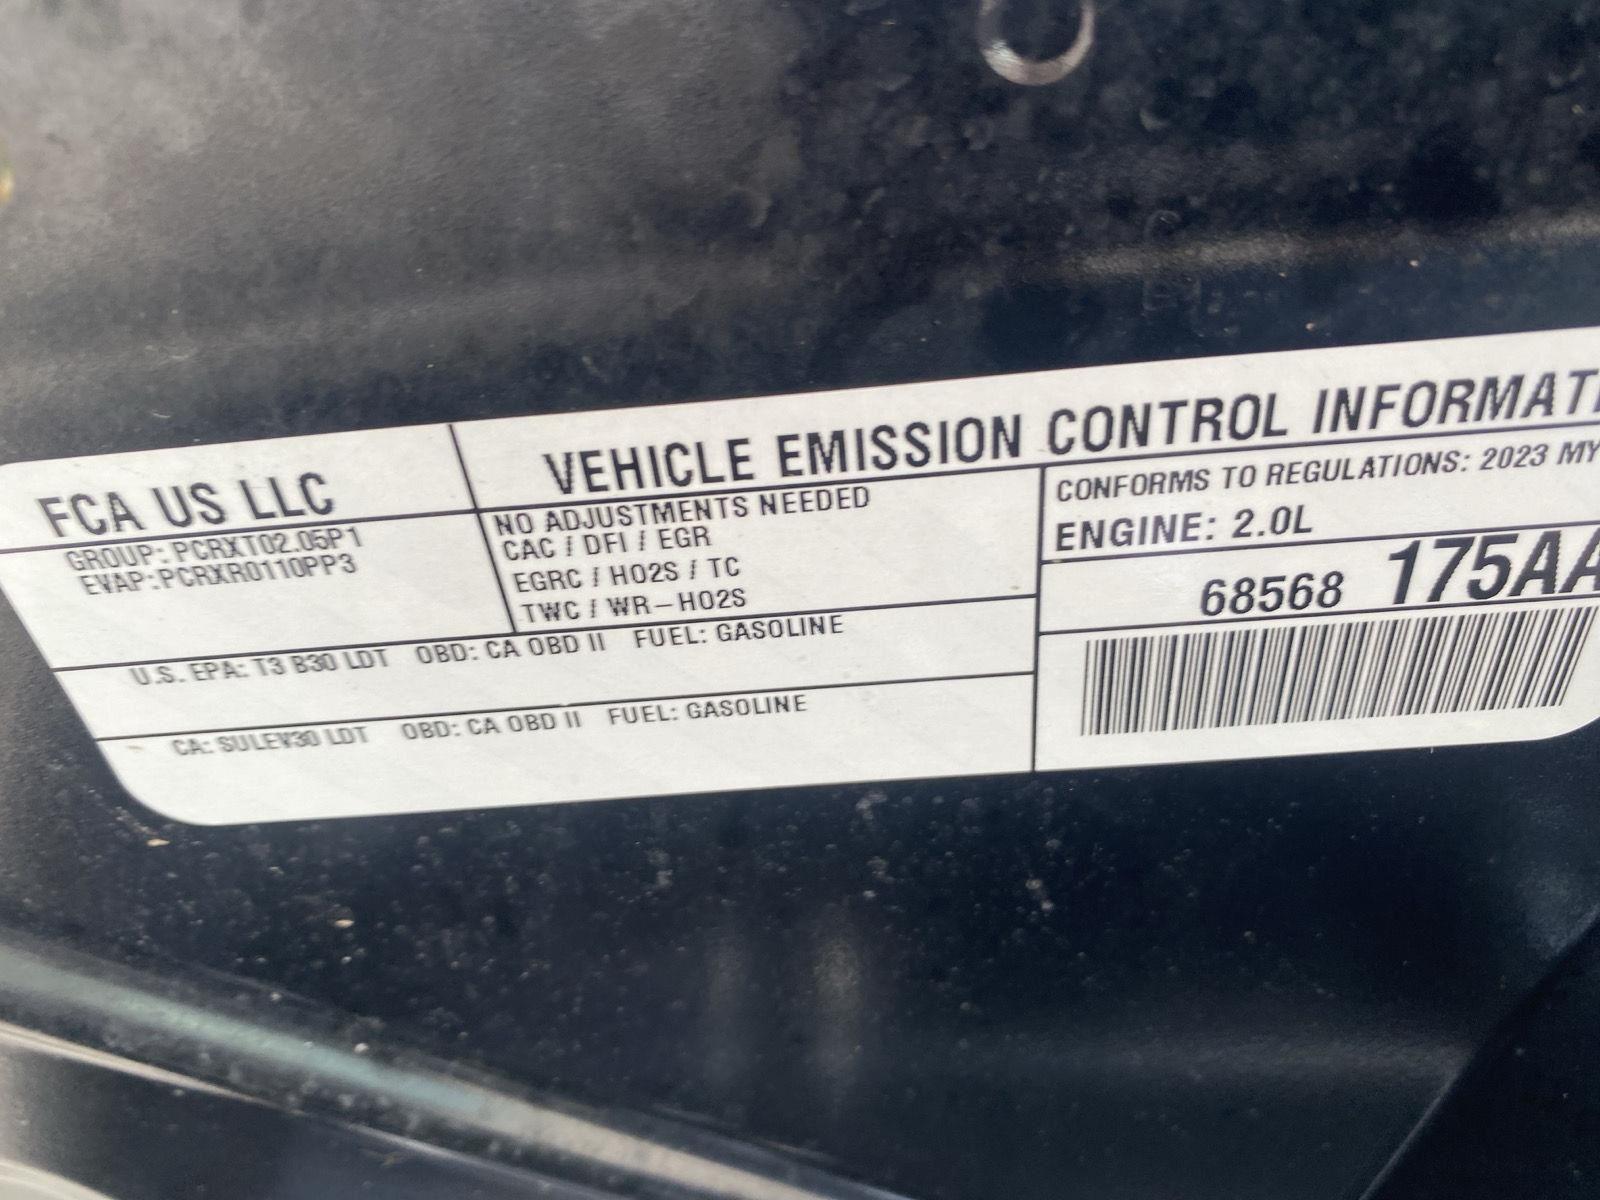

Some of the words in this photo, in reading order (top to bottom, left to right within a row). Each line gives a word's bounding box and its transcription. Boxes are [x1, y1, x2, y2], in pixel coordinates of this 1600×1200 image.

[544, 437, 754, 496] VEHICLE
[777, 414, 1022, 477] EMISSION
[1048, 393, 1288, 455] CONTROL
[1056, 469, 1210, 503] CONFORMS
[1223, 465, 1257, 489] TO
[1266, 453, 1471, 486] REGULATIONS:
[1479, 444, 1549, 471] 2023
[36, 491, 144, 537] FCA
[152, 482, 226, 527] US
[239, 472, 335, 520] LLC
[495, 512, 533, 536] NO
[546, 496, 749, 533] ADJUSTMENTS
[760, 486, 870, 516] NEEDED
[503, 537, 555, 561] CAC
[584, 531, 628, 556] DFI
[659, 525, 712, 550] EGR
[1056, 512, 1217, 552] ENGINE:
[1232, 505, 1313, 538] 2.0L
[514, 568, 582, 593] EGRC
[707, 556, 741, 579] TC
[520, 600, 580, 624] TWC
[1200, 571, 1345, 617] 68568
[416, 643, 479, 664] OBD:
[485, 639, 522, 659] CA
[528, 633, 580, 656] OBD
[588, 632, 606, 651] II
[633, 626, 707, 648] FUEL:
[716, 614, 845, 643] GASOLINE
[128, 664, 186, 686] U.S.
[191, 661, 249, 681] EPA:
[253, 657, 286, 677] T3
[293, 652, 338, 674] B30
[342, 648, 390, 670] LDT
[401, 721, 462, 740] OBD:
[468, 716, 500, 736] CA
[507, 712, 557, 733] OBD
[564, 711, 582, 728] II
[608, 704, 679, 726] FUEL:
[686, 694, 809, 720] GASOLINE
[171, 736, 214, 757] CA:
[218, 729, 321, 753] SULEV30
[322, 726, 371, 746] LDT
